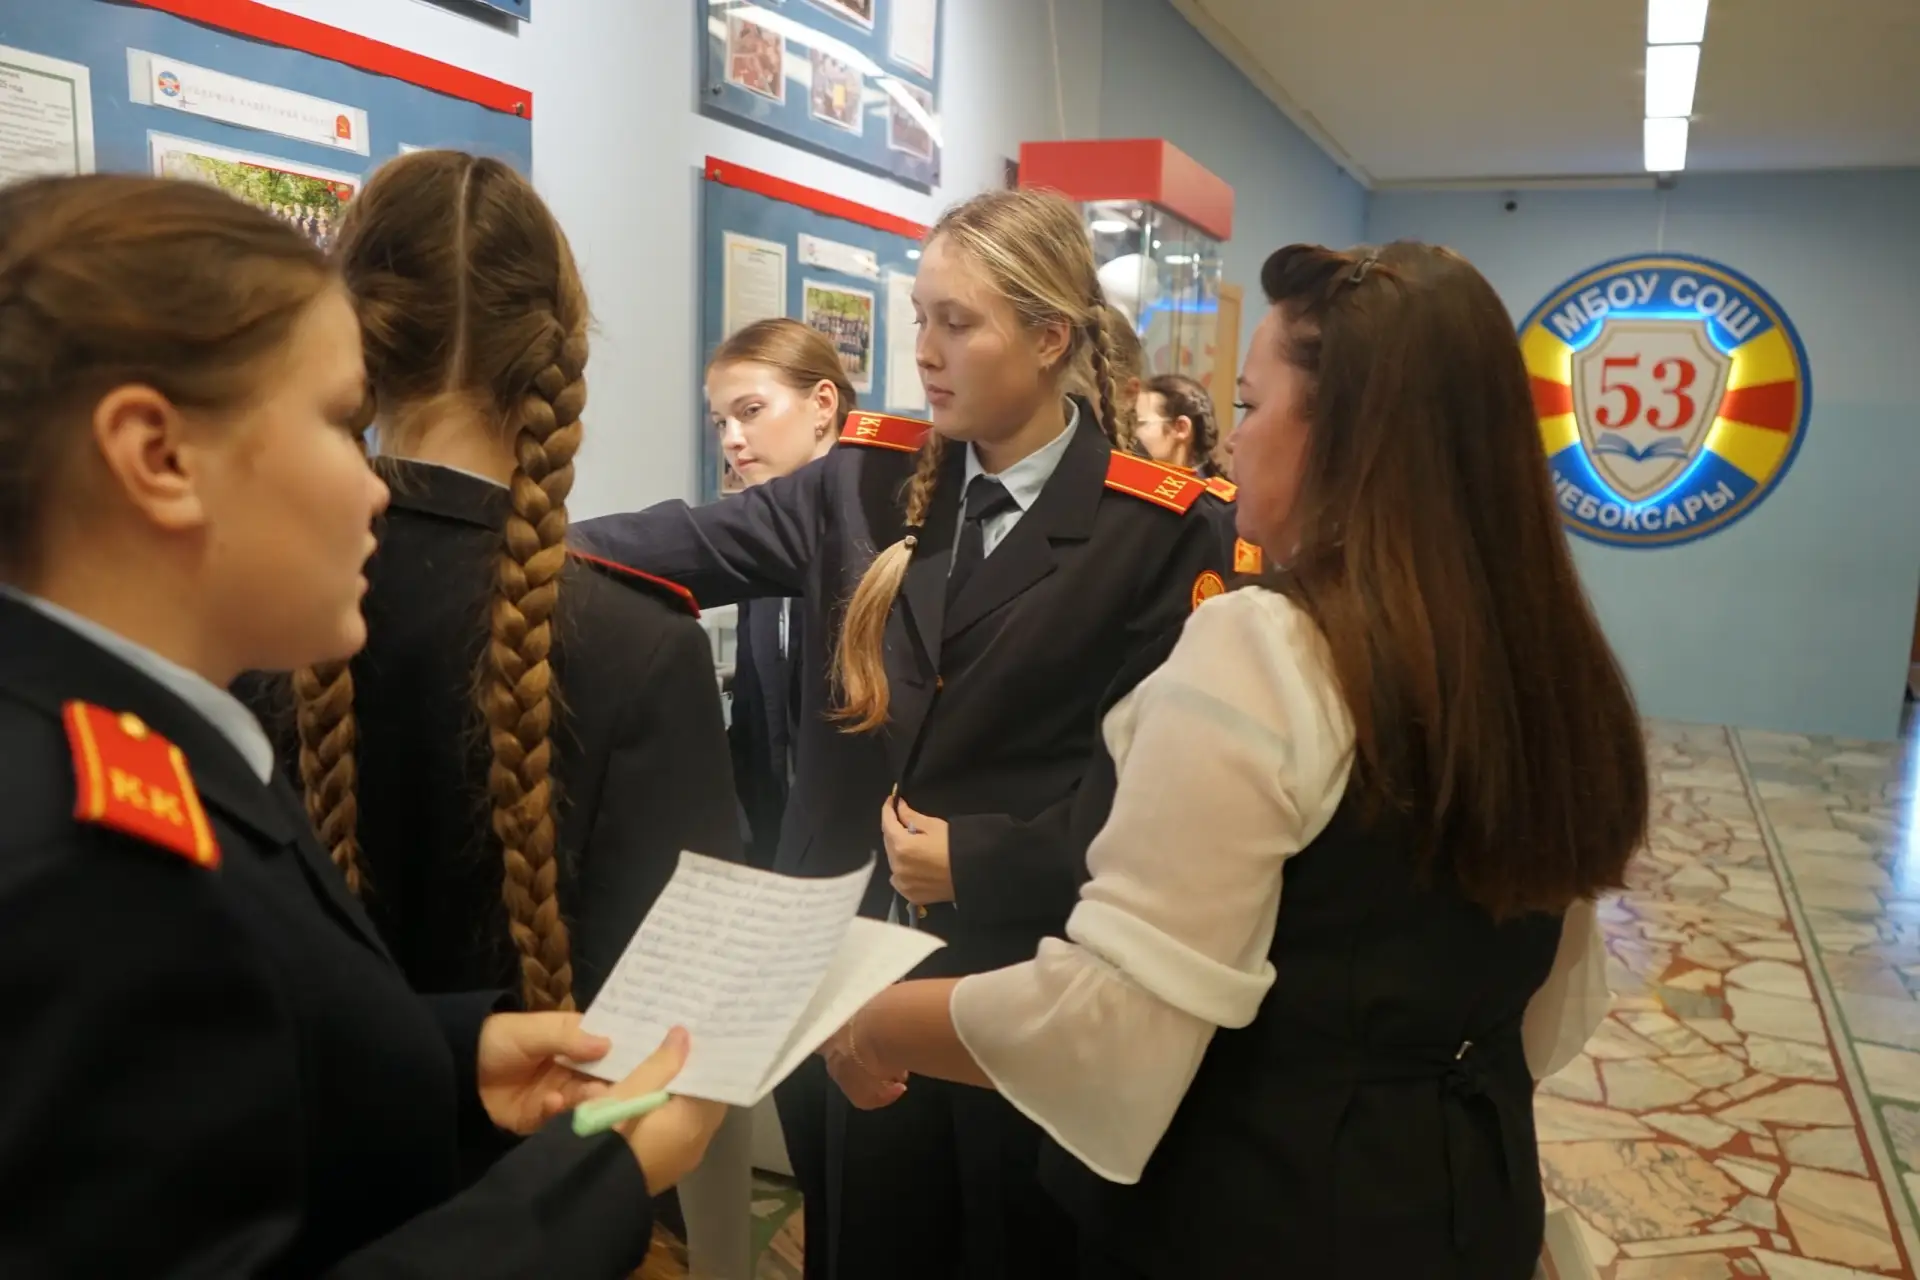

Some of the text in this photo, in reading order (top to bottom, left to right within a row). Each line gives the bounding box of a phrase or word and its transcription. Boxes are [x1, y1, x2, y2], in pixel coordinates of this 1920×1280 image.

[1551, 273, 1760, 340] МБОУ СОШ
[1595, 353, 1697, 431] 53
[1154, 475, 1188, 499] КК
